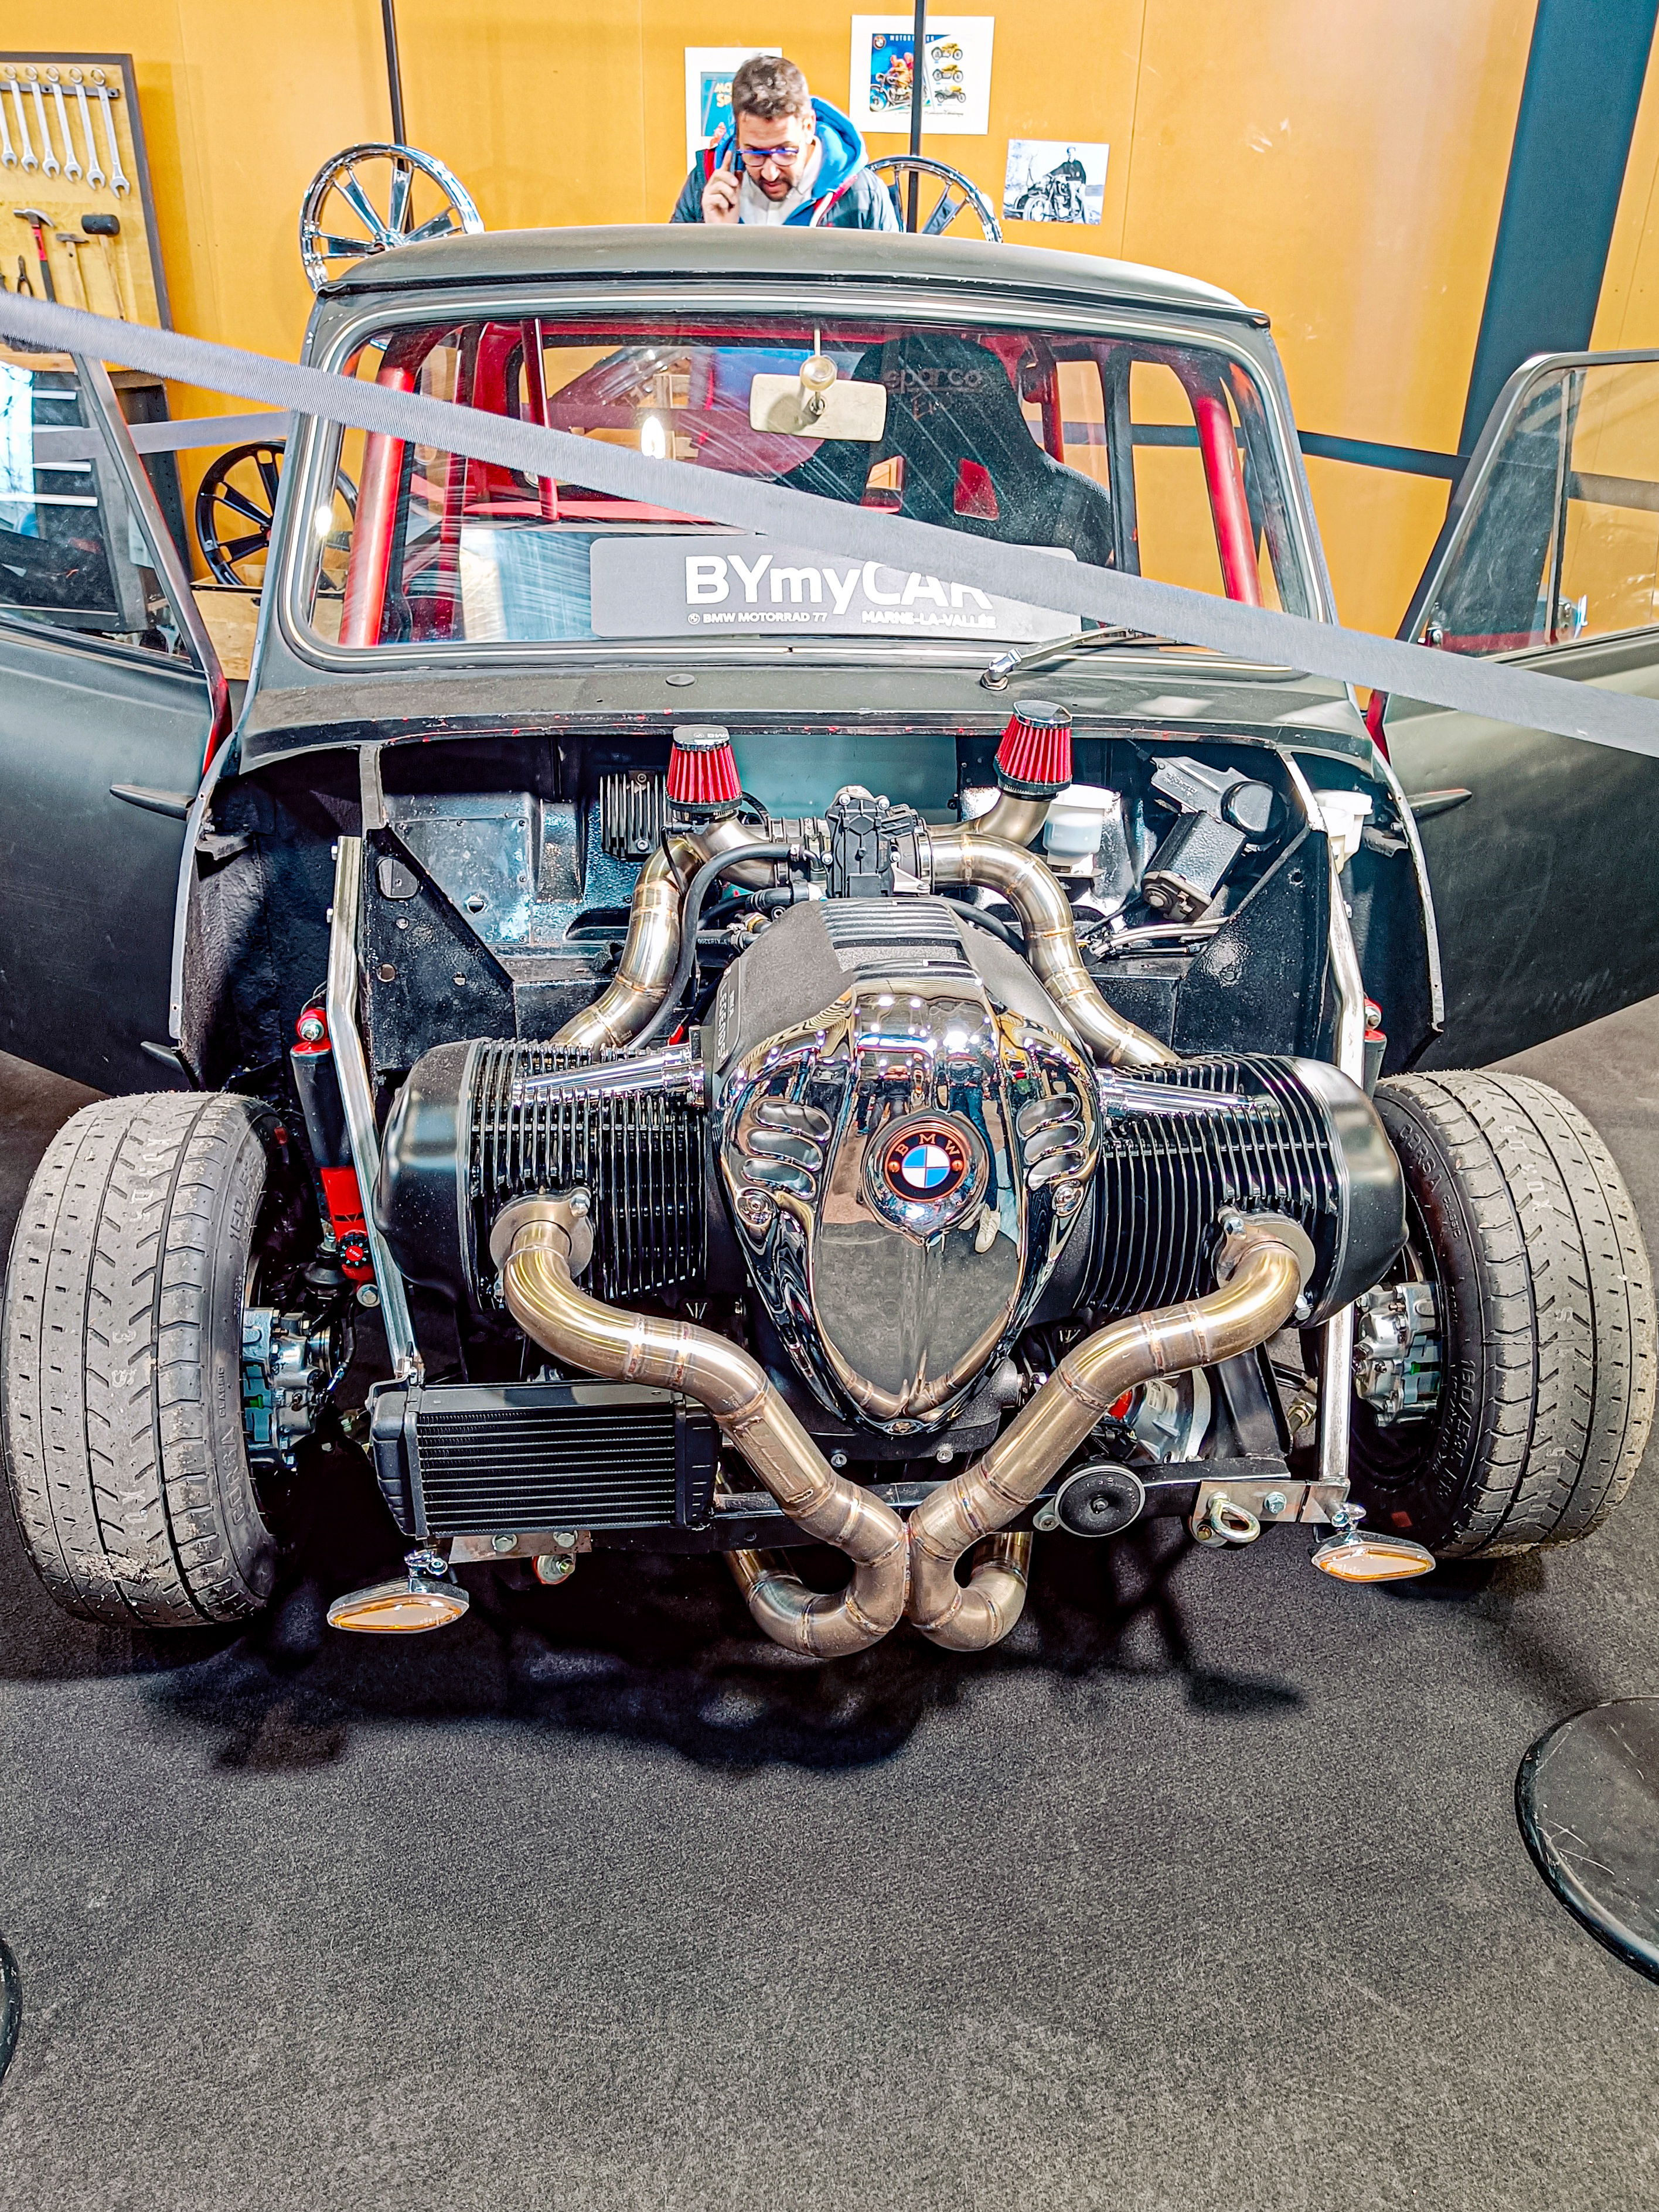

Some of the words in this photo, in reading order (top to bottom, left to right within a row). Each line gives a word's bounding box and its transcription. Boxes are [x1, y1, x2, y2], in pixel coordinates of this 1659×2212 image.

[713, 82, 733, 93] MO
[703, 613, 735, 623] BMW
[738, 612, 811, 622] MOTORRAD
[813, 612, 828, 622] 77
[861, 609, 996, 629] MARNE-LA-VALLÉE
[717, 982, 727, 1058] LEGENDS
[895, 1133, 960, 1157] BMW
[220, 1425, 247, 1526] CORSA
